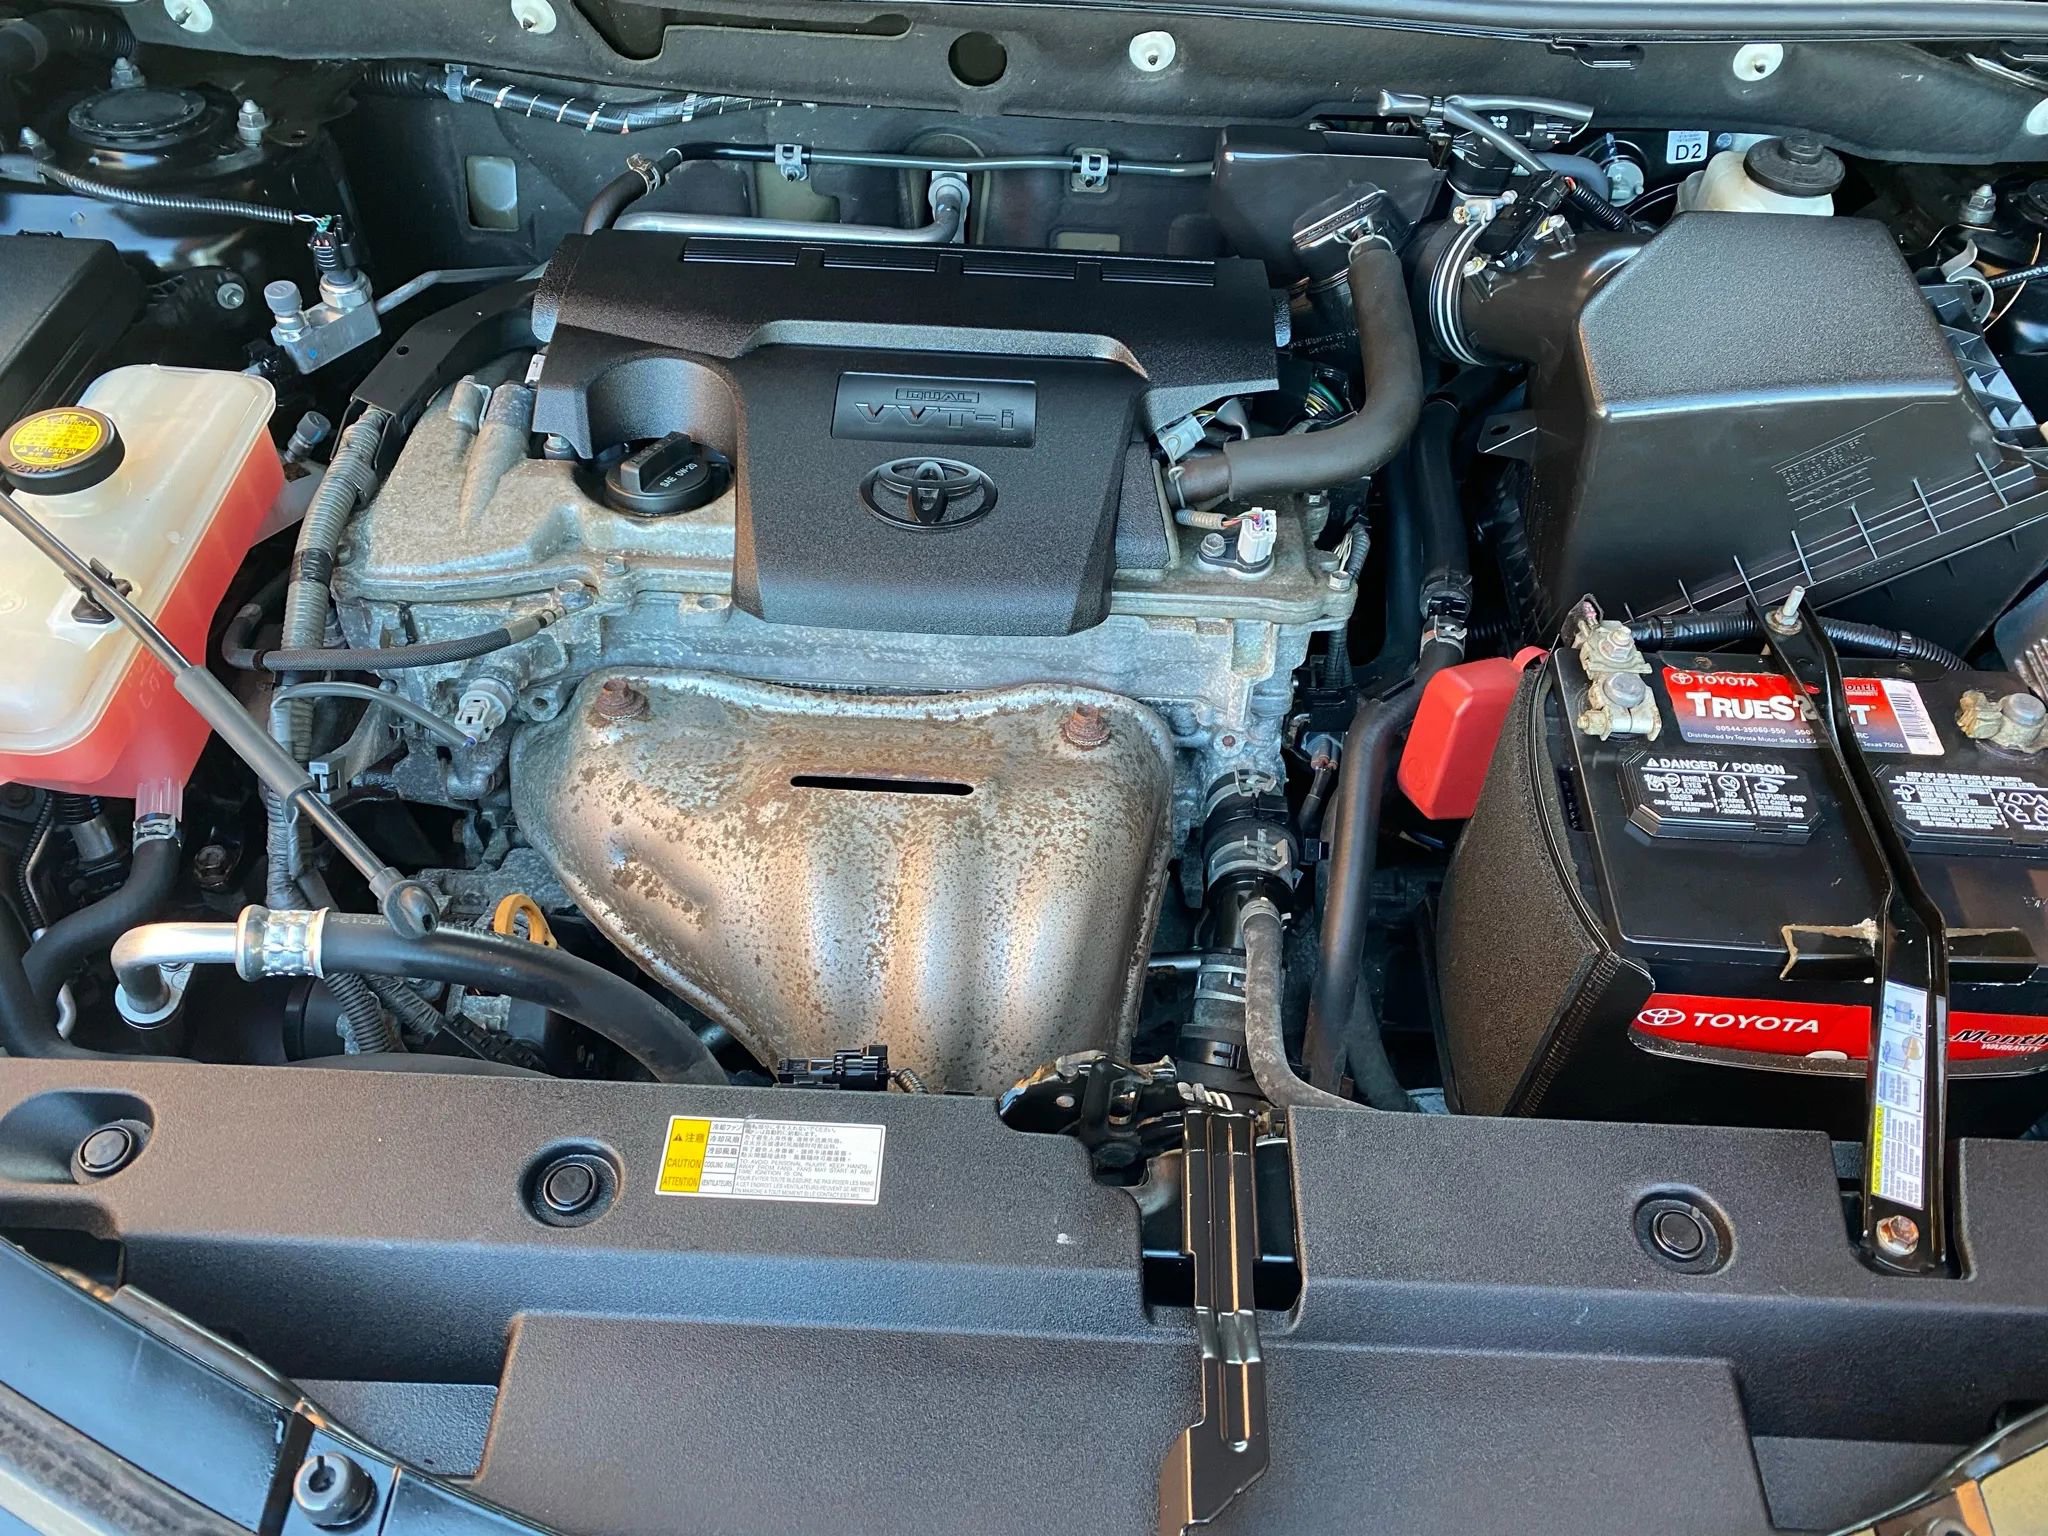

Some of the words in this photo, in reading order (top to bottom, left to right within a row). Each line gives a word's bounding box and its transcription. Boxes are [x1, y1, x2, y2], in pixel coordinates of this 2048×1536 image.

[1676, 143, 1702, 160] D2
[907, 390, 973, 403] DUAL
[855, 402, 1014, 430] VVT-i
[33, 446, 77, 455] ATTENTION
[660, 476, 677, 488] SAE
[675, 462, 698, 476] 0W-20
[1695, 674, 1758, 687] TOYOTA
[1687, 731, 1725, 740] Distributed
[1734, 734, 1757, 743] Toyota
[1660, 758, 1719, 771] DANGER
[1732, 762, 1786, 774] POISON
[1789, 794, 1807, 803] ACID
[1694, 1013, 1819, 1033] TOYOTA
[1981, 1044, 2042, 1052] WARRANTY
[667, 1158, 701, 1169] CAUTION
[662, 1177, 698, 1187] ATTENTION
